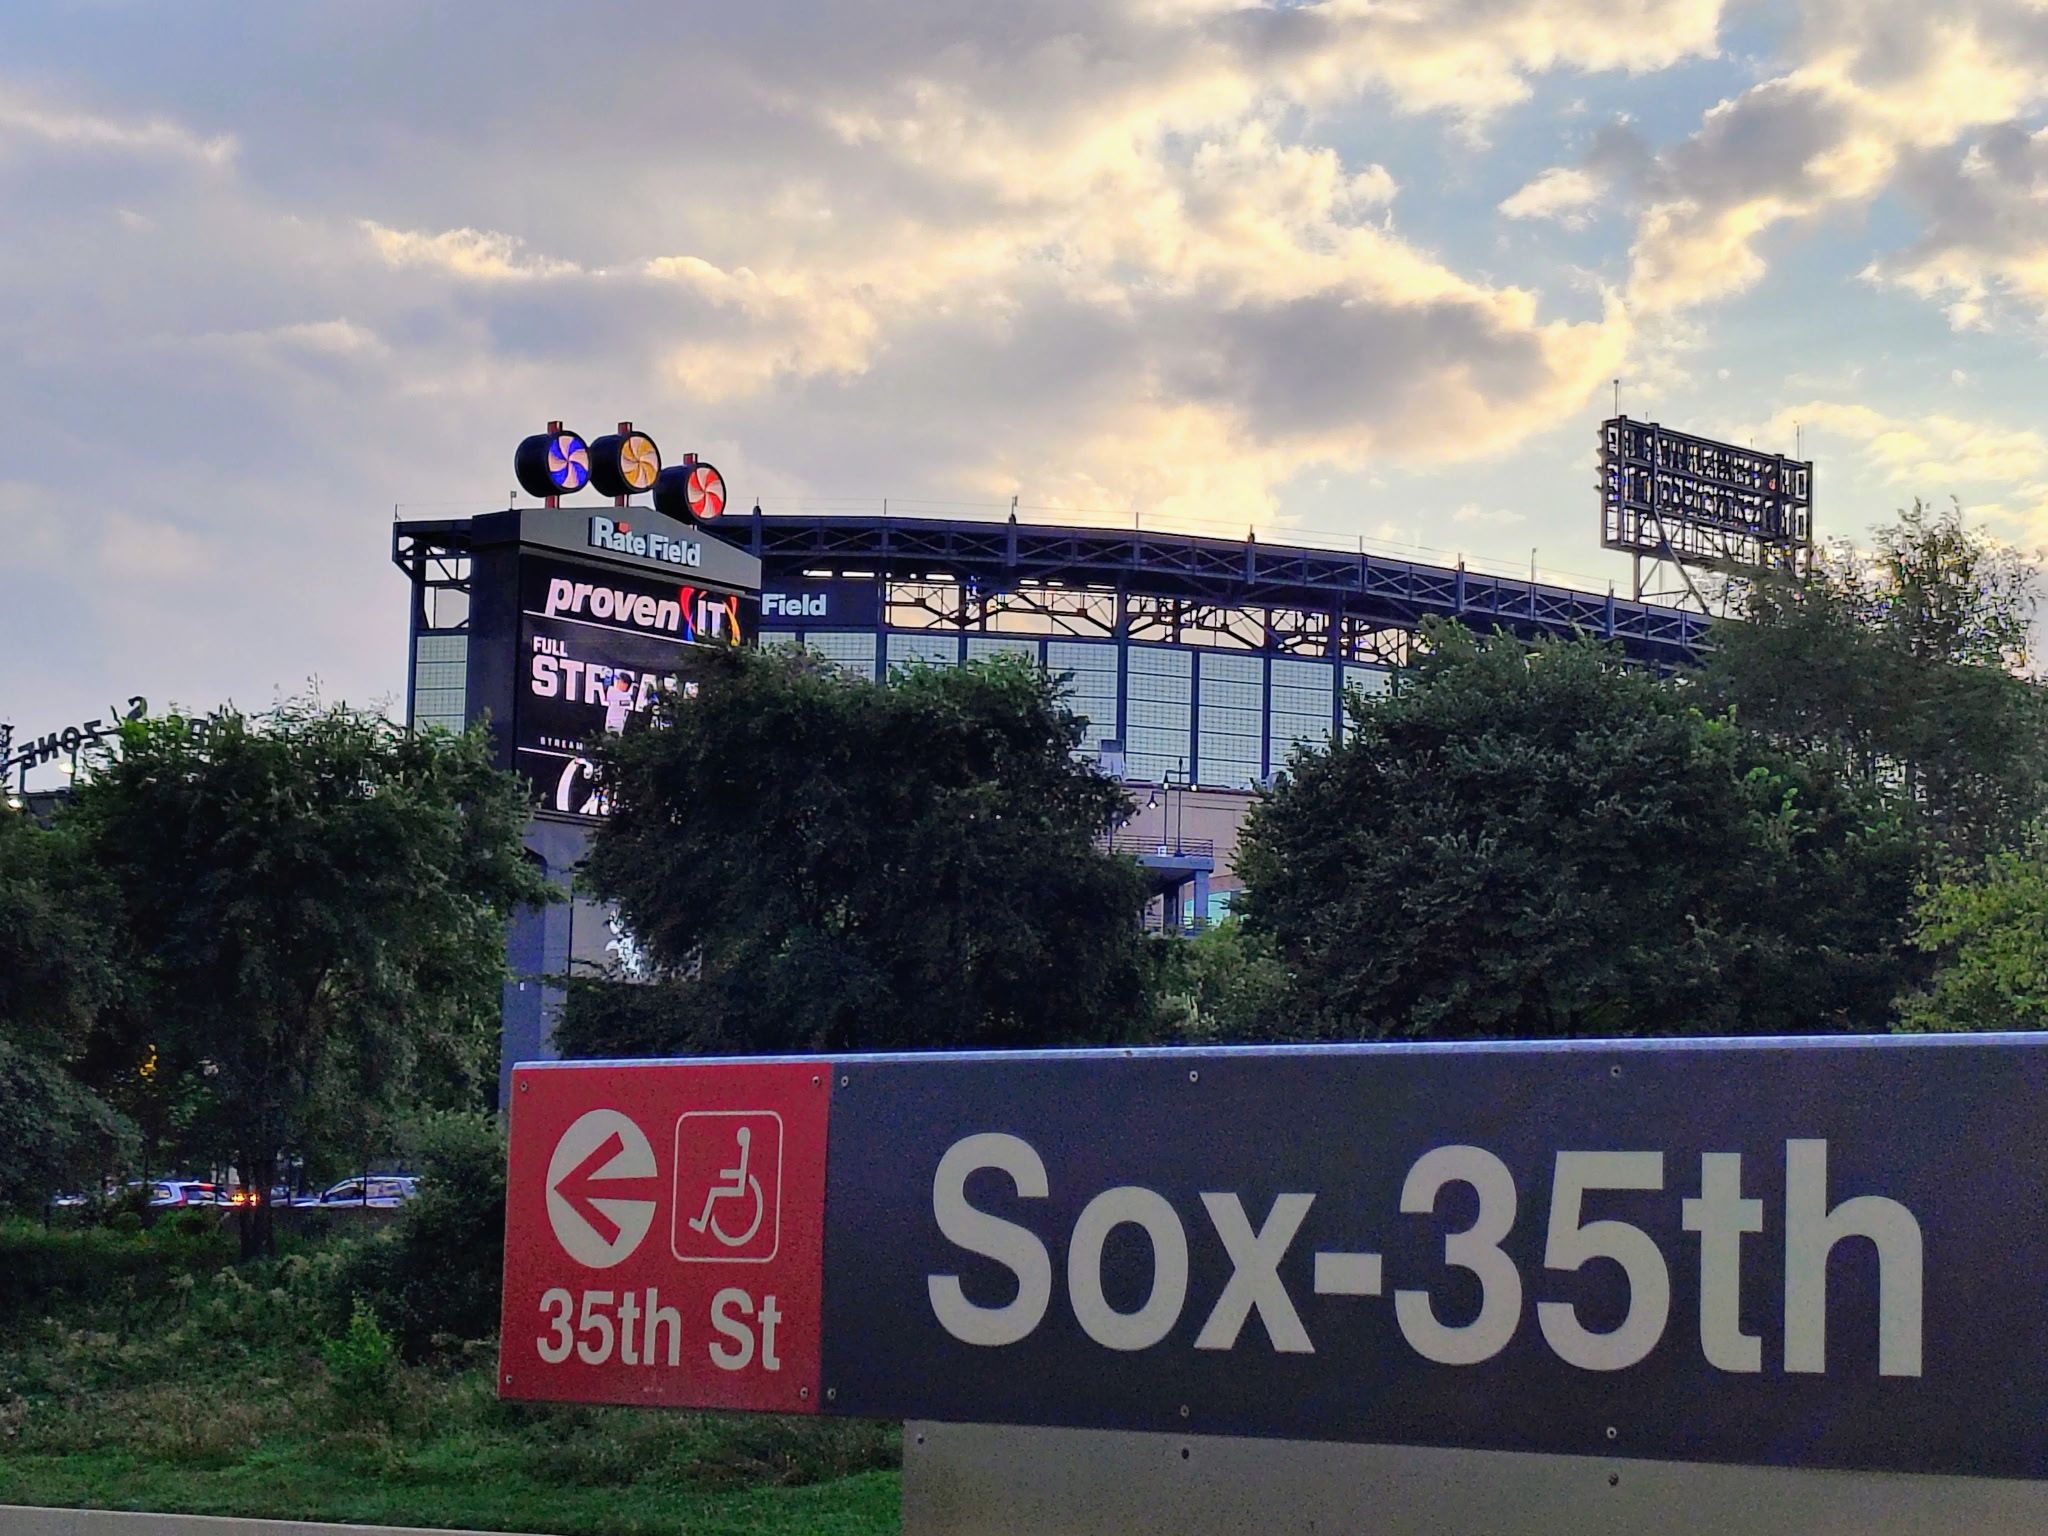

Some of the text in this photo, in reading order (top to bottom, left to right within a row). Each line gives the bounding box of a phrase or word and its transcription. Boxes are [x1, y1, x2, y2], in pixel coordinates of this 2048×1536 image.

[590, 517, 700, 567] Rate Field
[544, 578, 680, 631] proven
[761, 593, 826, 616] Field
[533, 636, 568, 657] FULL
[927, 1132, 1923, 1377] Sox-35th
[536, 1287, 781, 1371] 35th St
